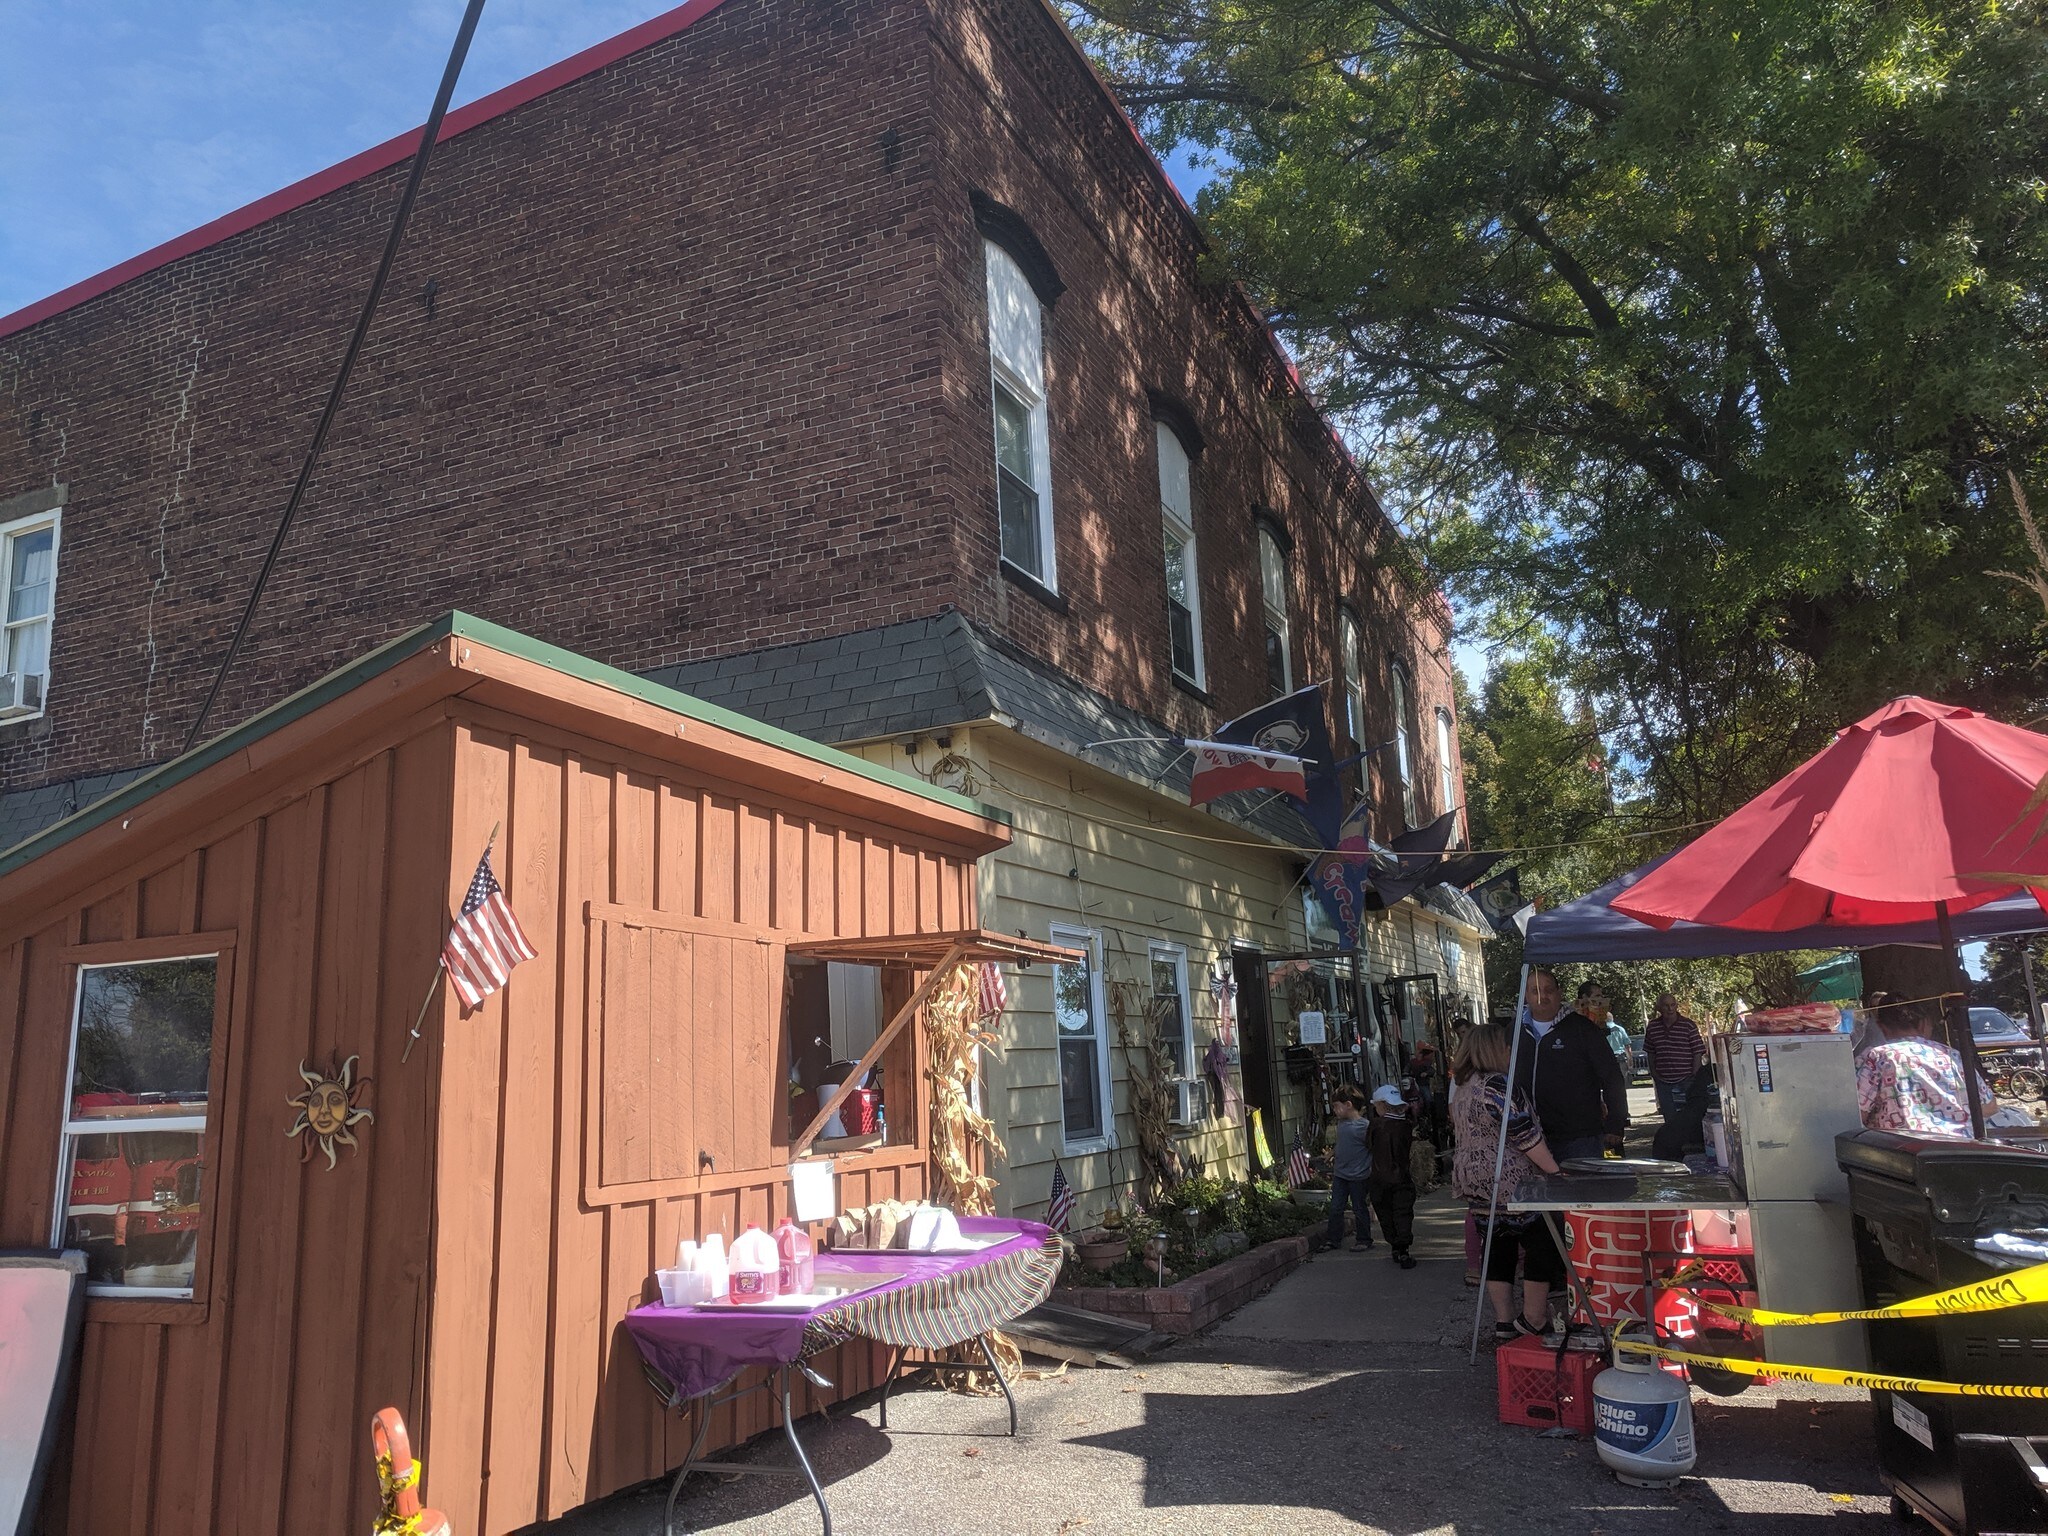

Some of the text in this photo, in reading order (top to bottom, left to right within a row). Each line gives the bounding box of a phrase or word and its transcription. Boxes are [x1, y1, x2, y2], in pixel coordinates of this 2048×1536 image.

[1935, 1278, 2028, 1311] CAUTION
[1599, 1402, 1637, 1421] Blue
[1598, 1416, 1649, 1437] Rhino
